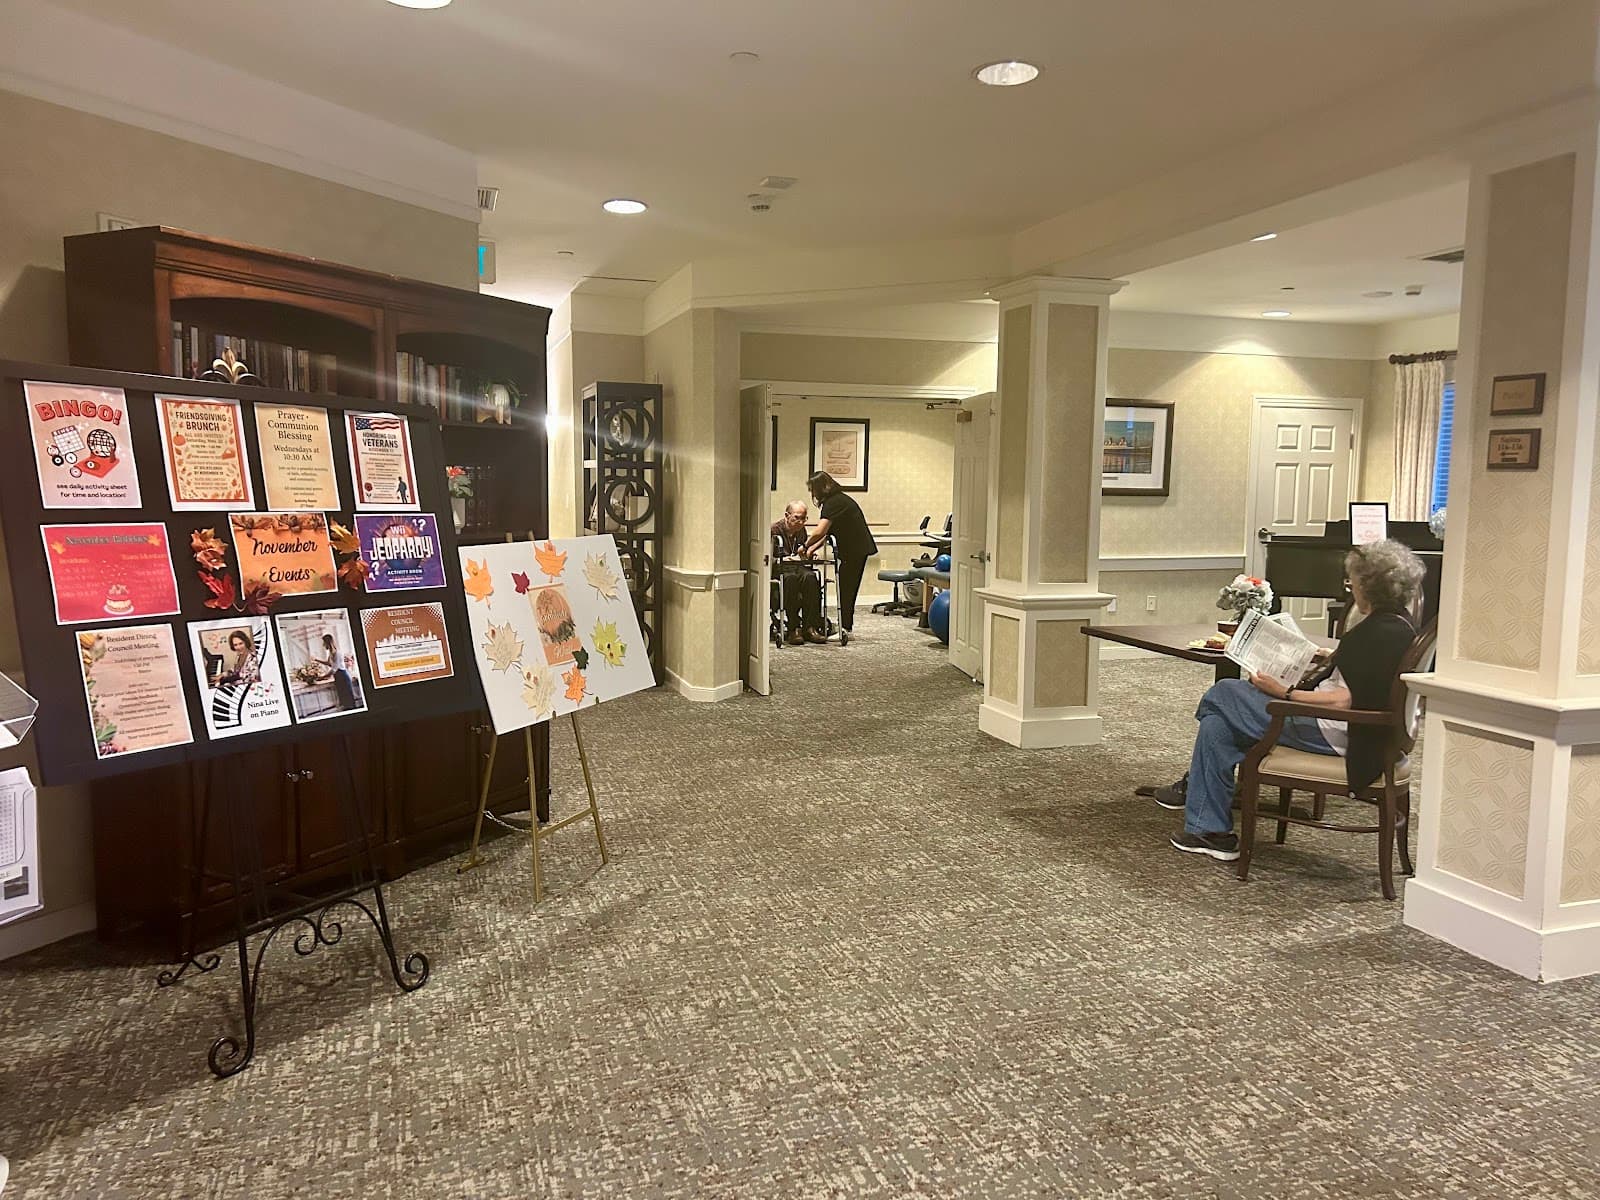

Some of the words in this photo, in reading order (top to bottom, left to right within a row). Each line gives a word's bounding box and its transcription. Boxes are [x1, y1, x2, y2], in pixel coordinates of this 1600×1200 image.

[35, 400, 122, 426] BINGO!
[175, 411, 227, 422] FRIENDSGIVING
[277, 410, 304, 421] Prayer
[185, 421, 220, 431] BRUNCH
[267, 420, 319, 431] Communion
[278, 430, 312, 442] Blessing
[362, 438, 399, 448] VETERANS
[274, 444, 312, 454] Wednesdays
[251, 537, 318, 556] November
[369, 536, 434, 560] JEOPARDY!
[269, 566, 310, 583] Events
[387, 609, 413, 617] RESIDENT
[391, 618, 414, 626] COUNCIL
[395, 625, 420, 633] MEETING
[106, 634, 134, 642] Resident
[135, 633, 157, 641] Dining
[107, 644, 133, 652] Council
[134, 642, 160, 650] Meeting
[260, 709, 279, 717] Piano
